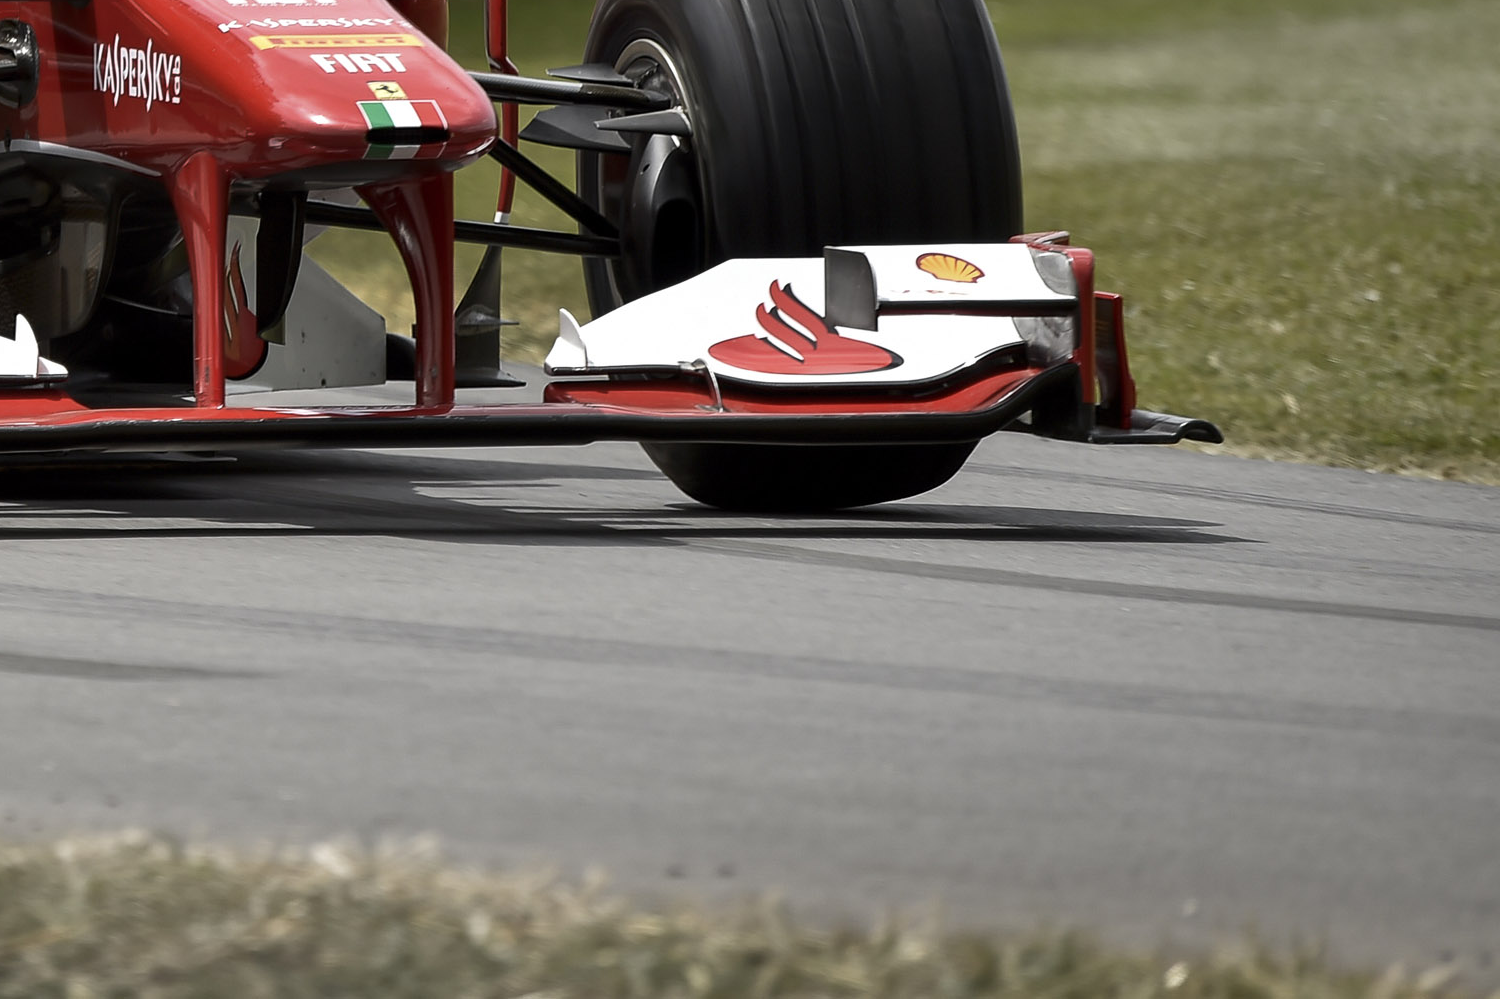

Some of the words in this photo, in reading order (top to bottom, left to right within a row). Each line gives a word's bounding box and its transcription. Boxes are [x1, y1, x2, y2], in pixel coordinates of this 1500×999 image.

[217, 17, 395, 33] KASPERSKY
[93, 33, 174, 113] KASPERSKY
[309, 53, 407, 73] FIAT
